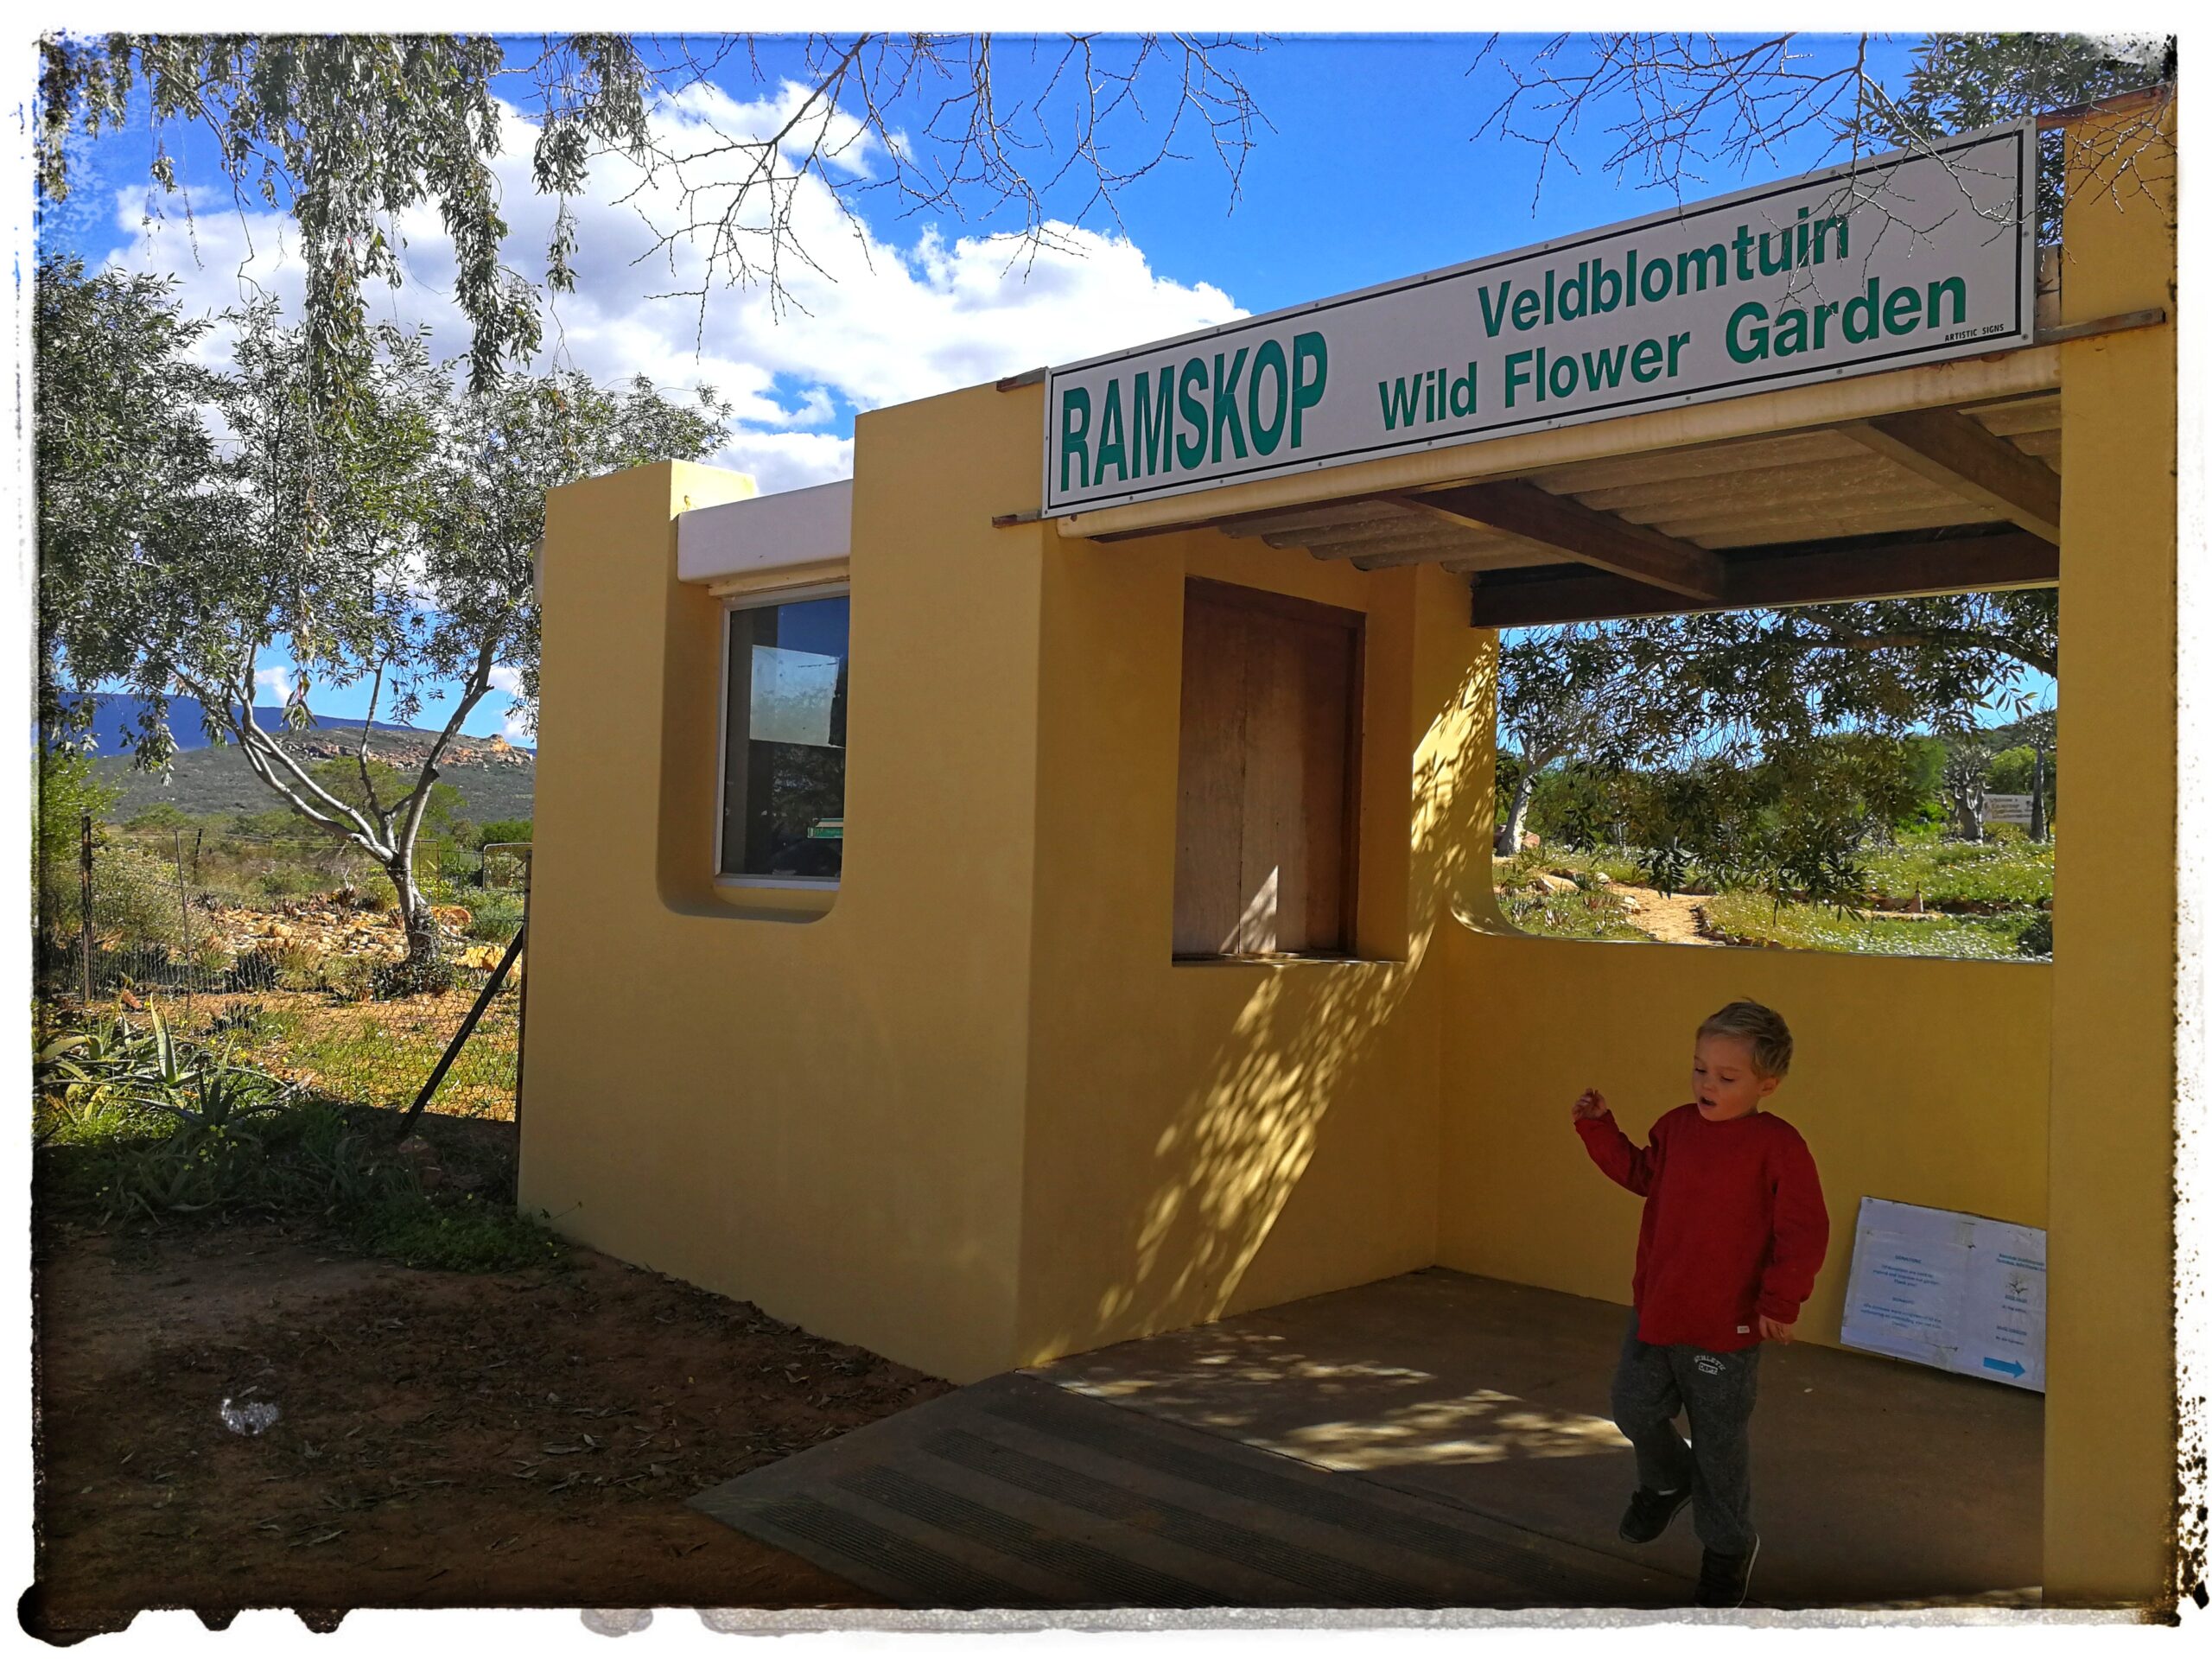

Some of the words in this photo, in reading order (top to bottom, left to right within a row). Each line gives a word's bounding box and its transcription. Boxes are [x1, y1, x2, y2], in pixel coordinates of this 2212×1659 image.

[1478, 206, 1848, 338] Veldblomtuin
[1944, 328, 1978, 342] ARTISTIC
[1981, 323, 2005, 335] SIGNS
[1060, 331, 1328, 493] RAMSKOP
[1378, 361, 1478, 430] Wild
[1504, 332, 1690, 408] Flower
[1726, 276, 1966, 364] Garden
